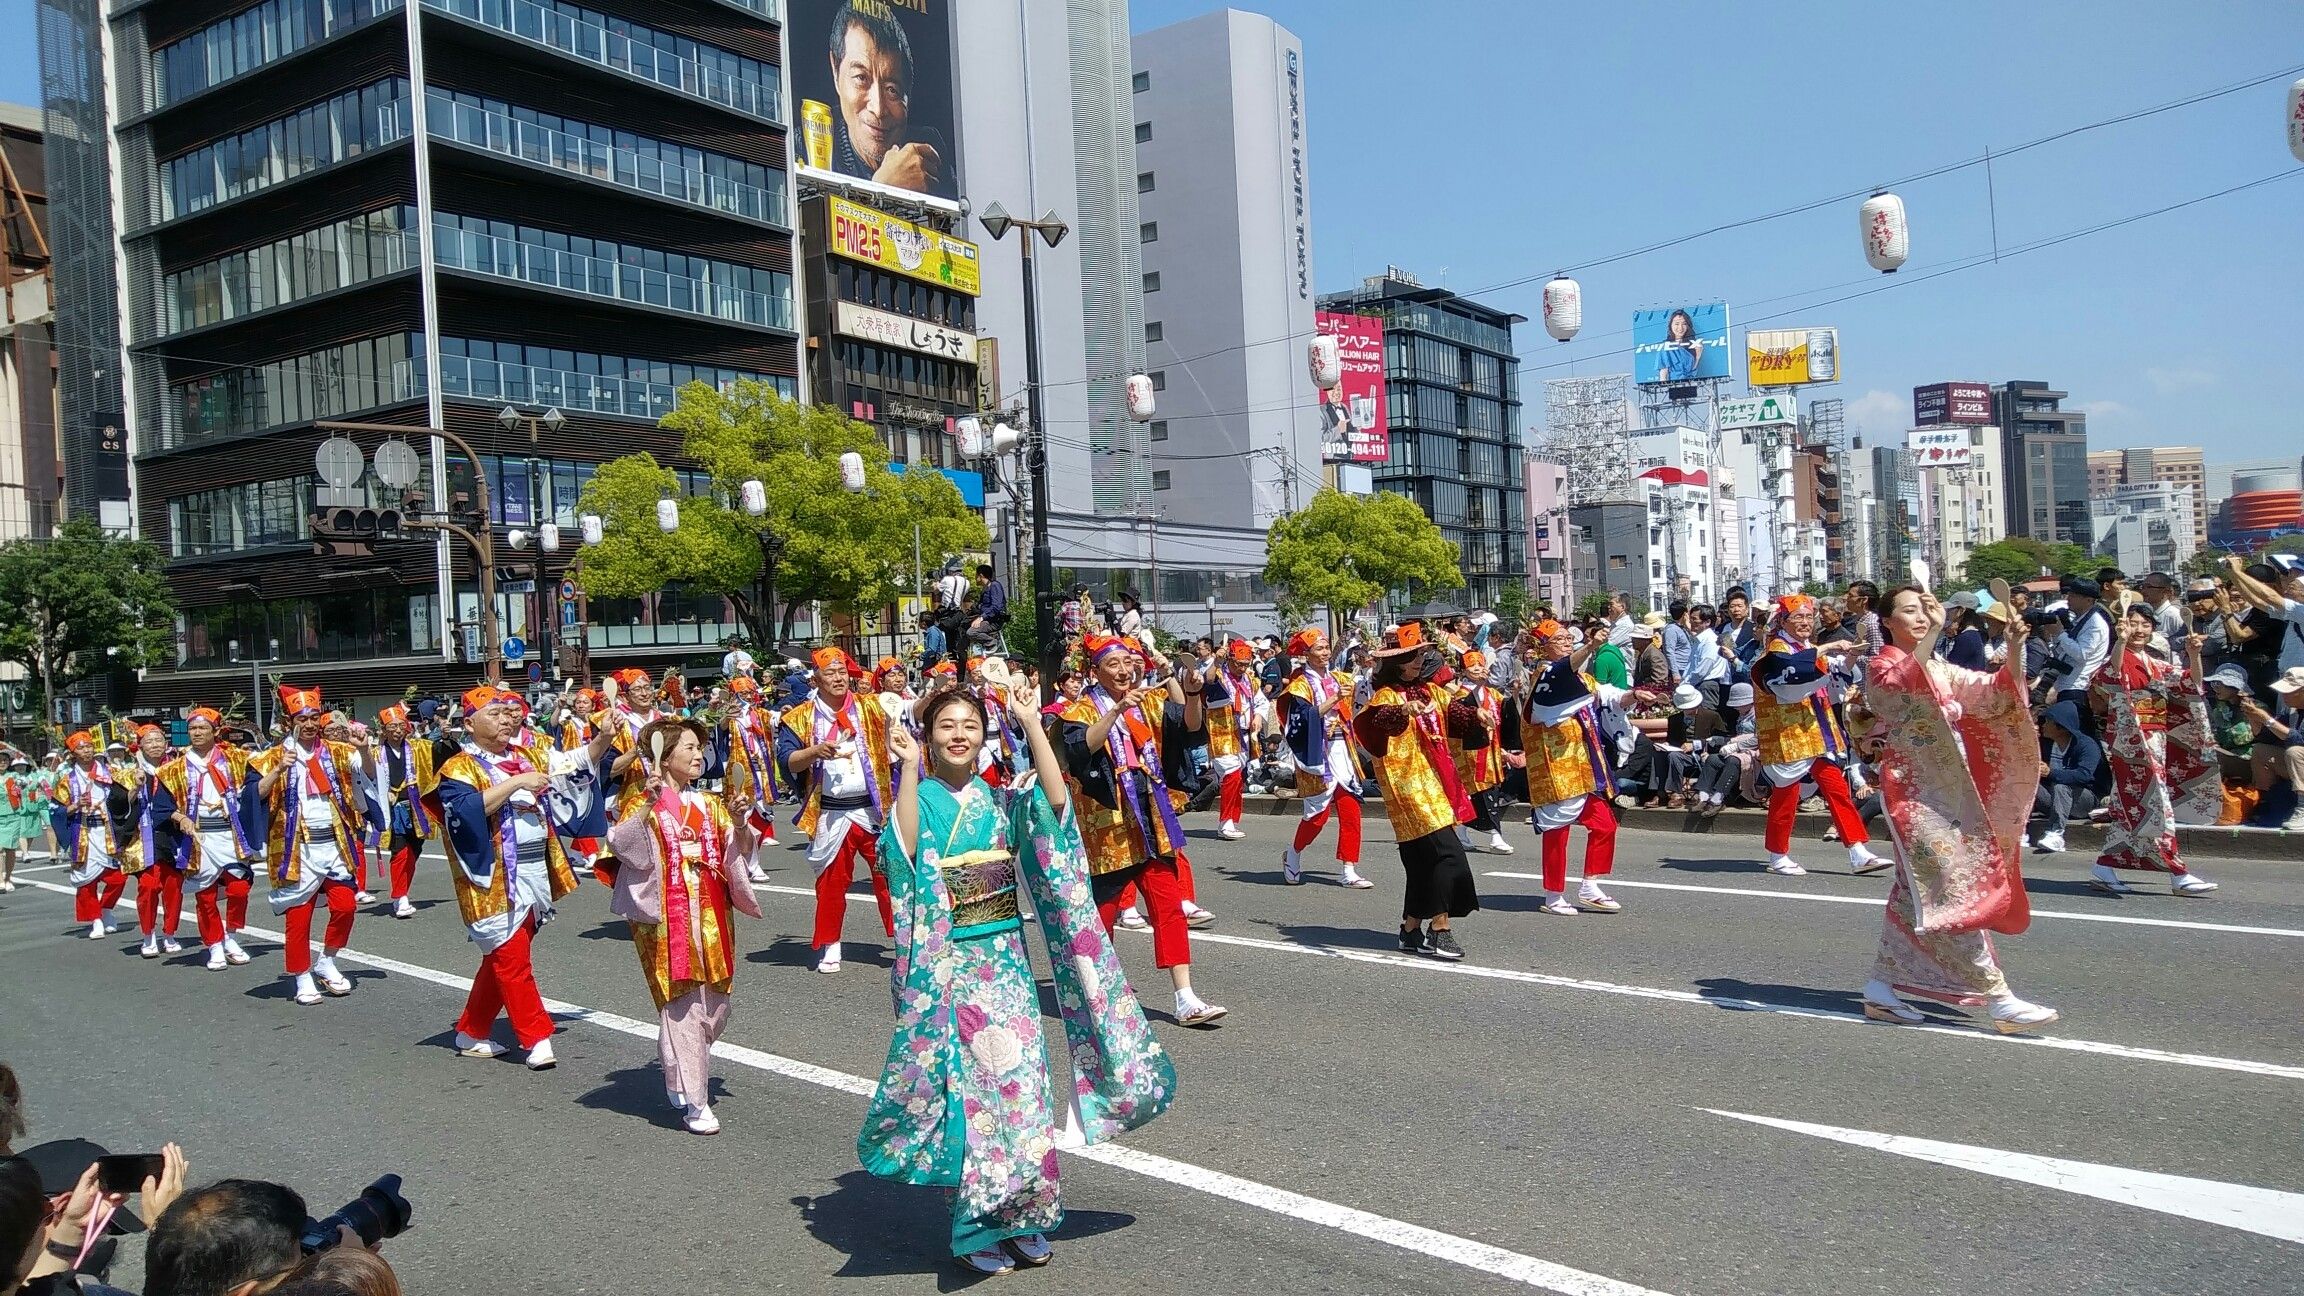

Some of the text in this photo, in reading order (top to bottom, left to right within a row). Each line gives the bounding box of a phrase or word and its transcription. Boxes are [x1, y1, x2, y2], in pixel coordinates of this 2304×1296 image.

[852, 0, 891, 21] MALT'S
[836, 215, 881, 262] PM2.5
[910, 320, 963, 357] しょうき
[1635, 336, 1727, 354] ハッピーメール
[1362, 352, 1380, 361] HAIR
[1720, 403, 1756, 415] ウチヤマ
[1720, 413, 1756, 425] グループ
[1325, 443, 1385, 455] 0120-494-111
